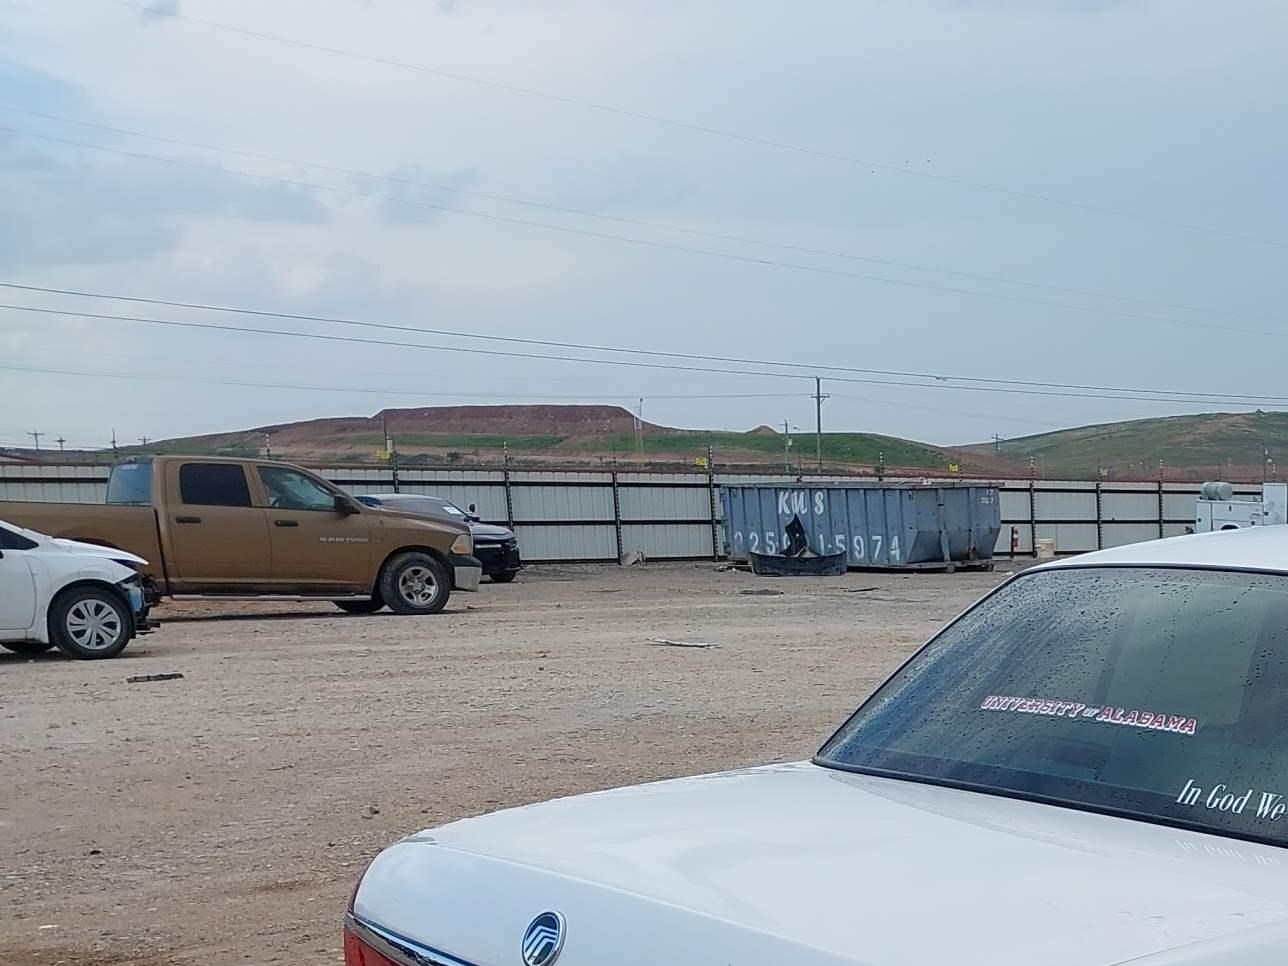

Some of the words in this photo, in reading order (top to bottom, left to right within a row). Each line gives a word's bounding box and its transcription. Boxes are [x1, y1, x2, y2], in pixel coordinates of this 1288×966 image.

[981, 695, 1085, 717] UNIVERSITY
[1097, 706, 1198, 735] ALABAMA
[1174, 779, 1202, 806] In
[1206, 783, 1254, 814] God
[1256, 791, 1286, 821] We
